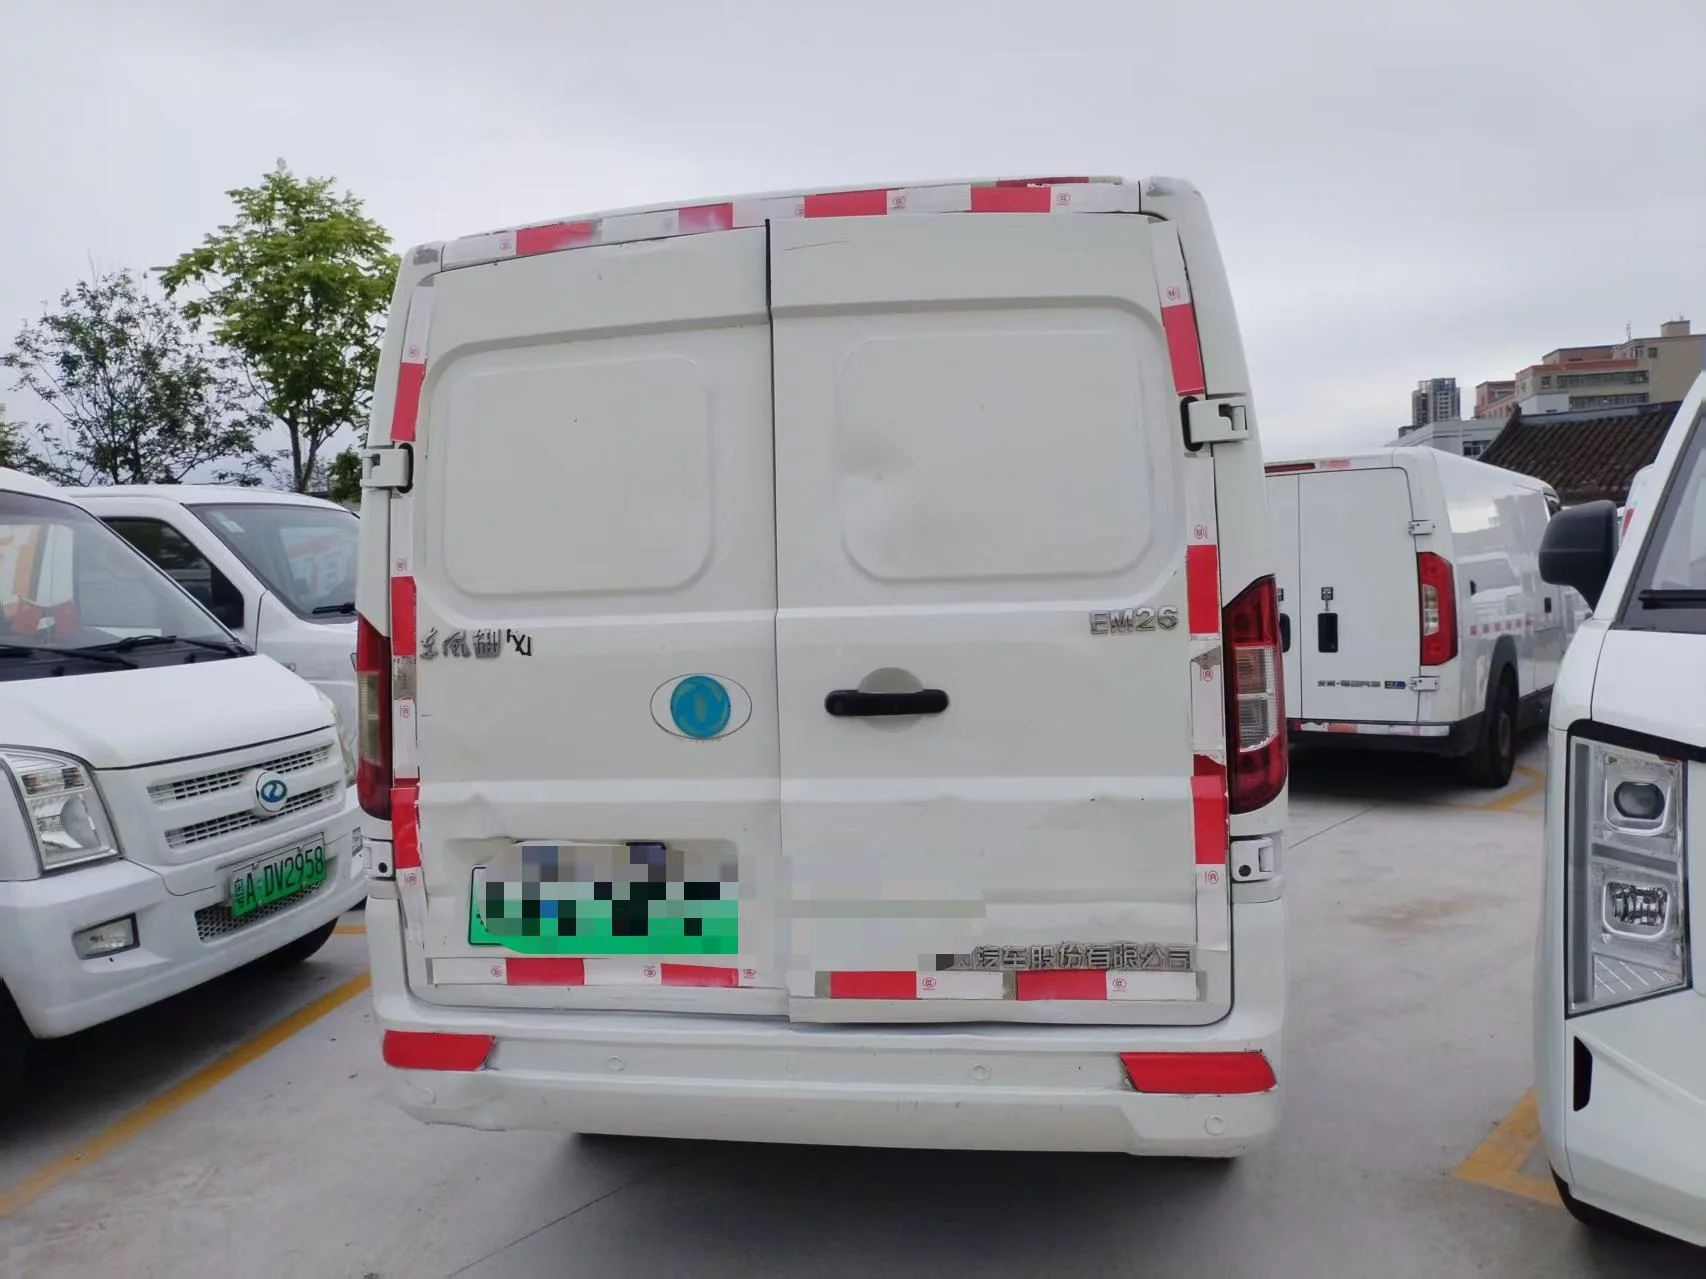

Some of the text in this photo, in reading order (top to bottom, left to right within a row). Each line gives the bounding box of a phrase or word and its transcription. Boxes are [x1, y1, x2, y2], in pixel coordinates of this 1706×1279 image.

[1089, 605, 1179, 635] EM26
[957, 941, 1193, 970] 汽车股份有限公司
